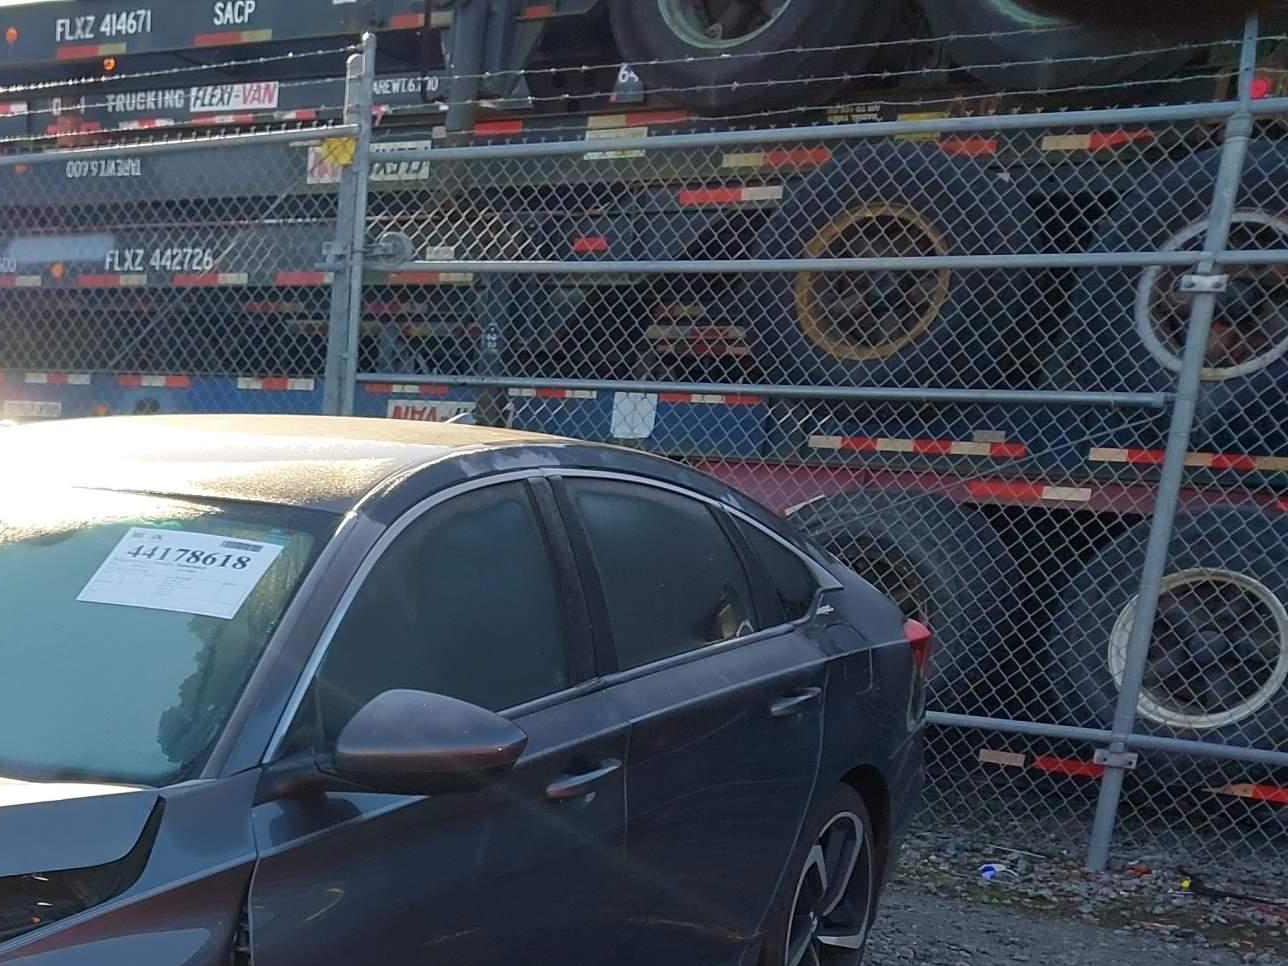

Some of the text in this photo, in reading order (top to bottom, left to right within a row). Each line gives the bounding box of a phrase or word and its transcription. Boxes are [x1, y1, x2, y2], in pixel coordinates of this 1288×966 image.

[55, 9, 153, 42] FLXZ 414671
[213, 1, 256, 26] SACP
[106, 89, 185, 113] TRUCKING
[192, 83, 278, 109] FLEXI-VAN
[104, 247, 213, 272] FLXZ 442726
[127, 544, 252, 570] 44178618
